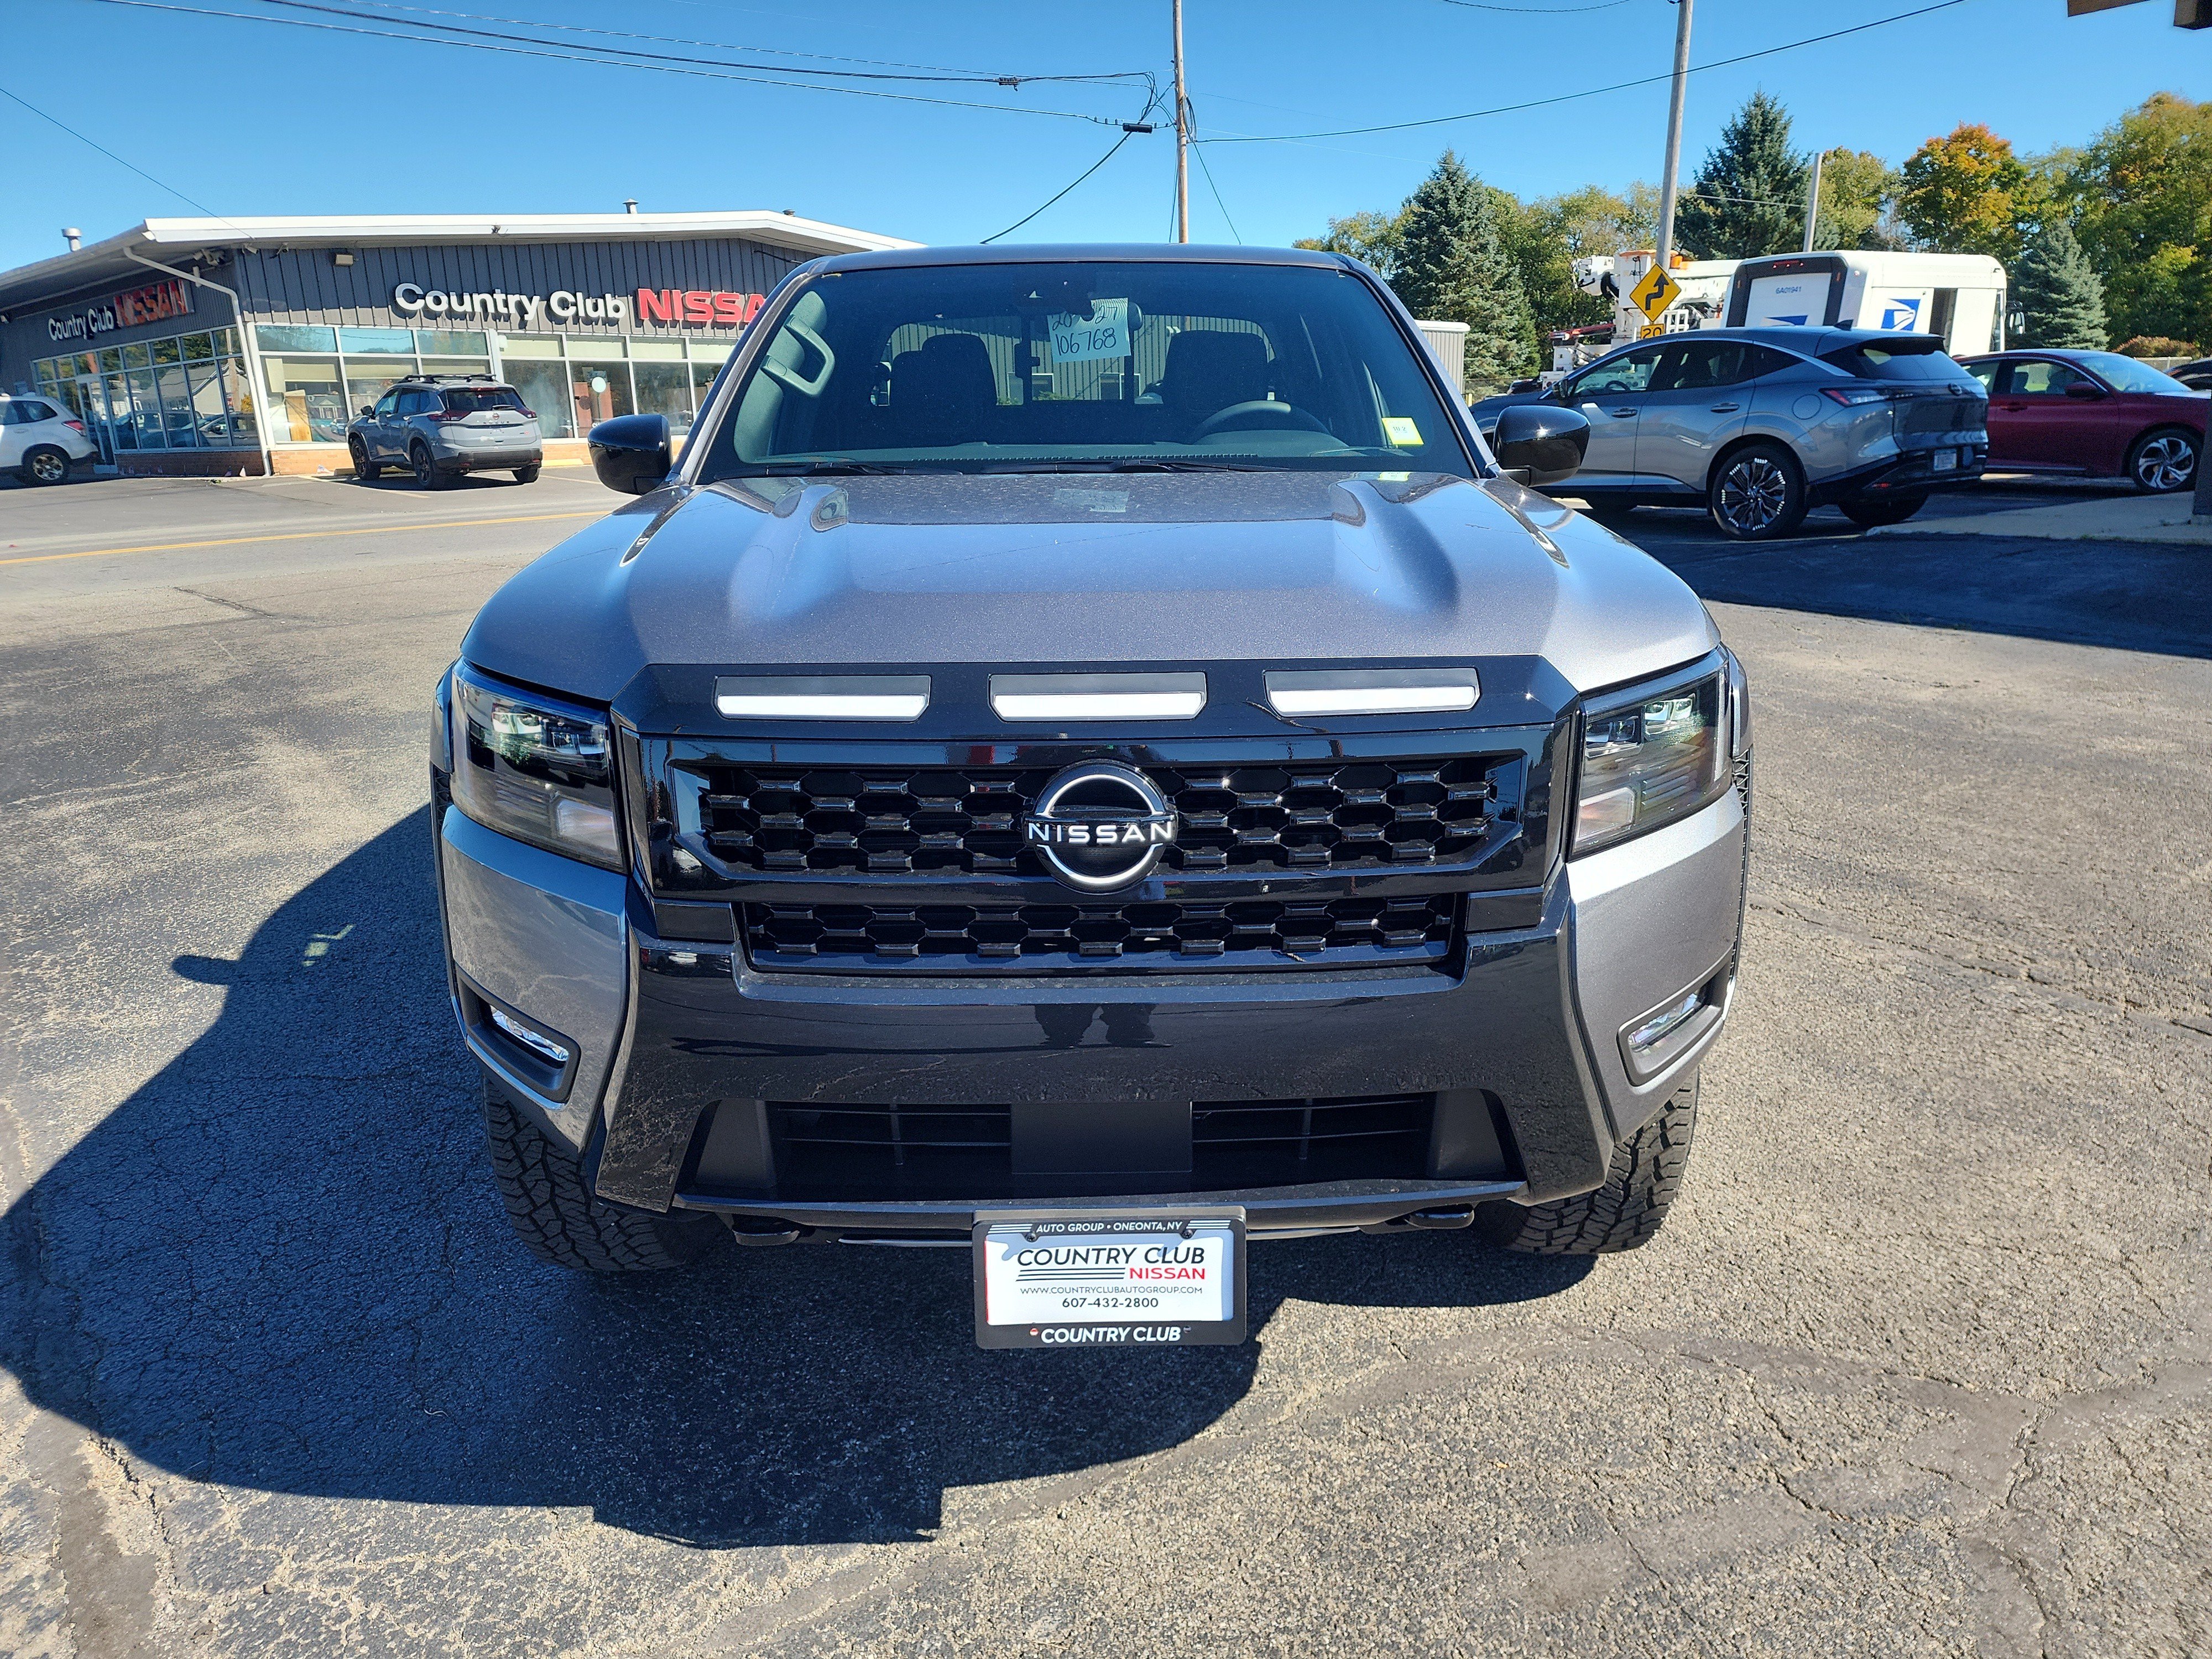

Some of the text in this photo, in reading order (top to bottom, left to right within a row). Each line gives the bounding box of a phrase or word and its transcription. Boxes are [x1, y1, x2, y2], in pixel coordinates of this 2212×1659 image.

[48, 278, 188, 341] Country Club NISSAN
[395, 283, 766, 322] Country Club NISSA
[1642, 327, 1662, 339] 20
[1056, 327, 1117, 356] 106768
[1028, 823, 1172, 844] NISSAN
[1036, 1223, 1065, 1233] AUTO
[1067, 1222, 1104, 1232] GROUP
[1017, 1247, 1204, 1266] COUNTRY CLUB
[1130, 1267, 1205, 1280] NISSAN
[1020, 1286, 1202, 1294] WWW.COUNTRYCLUBAUTOGROUP.COM
[1062, 1297, 1159, 1308] 607-432-2800
[1041, 1327, 1181, 1343] COUNTRY CLUB
